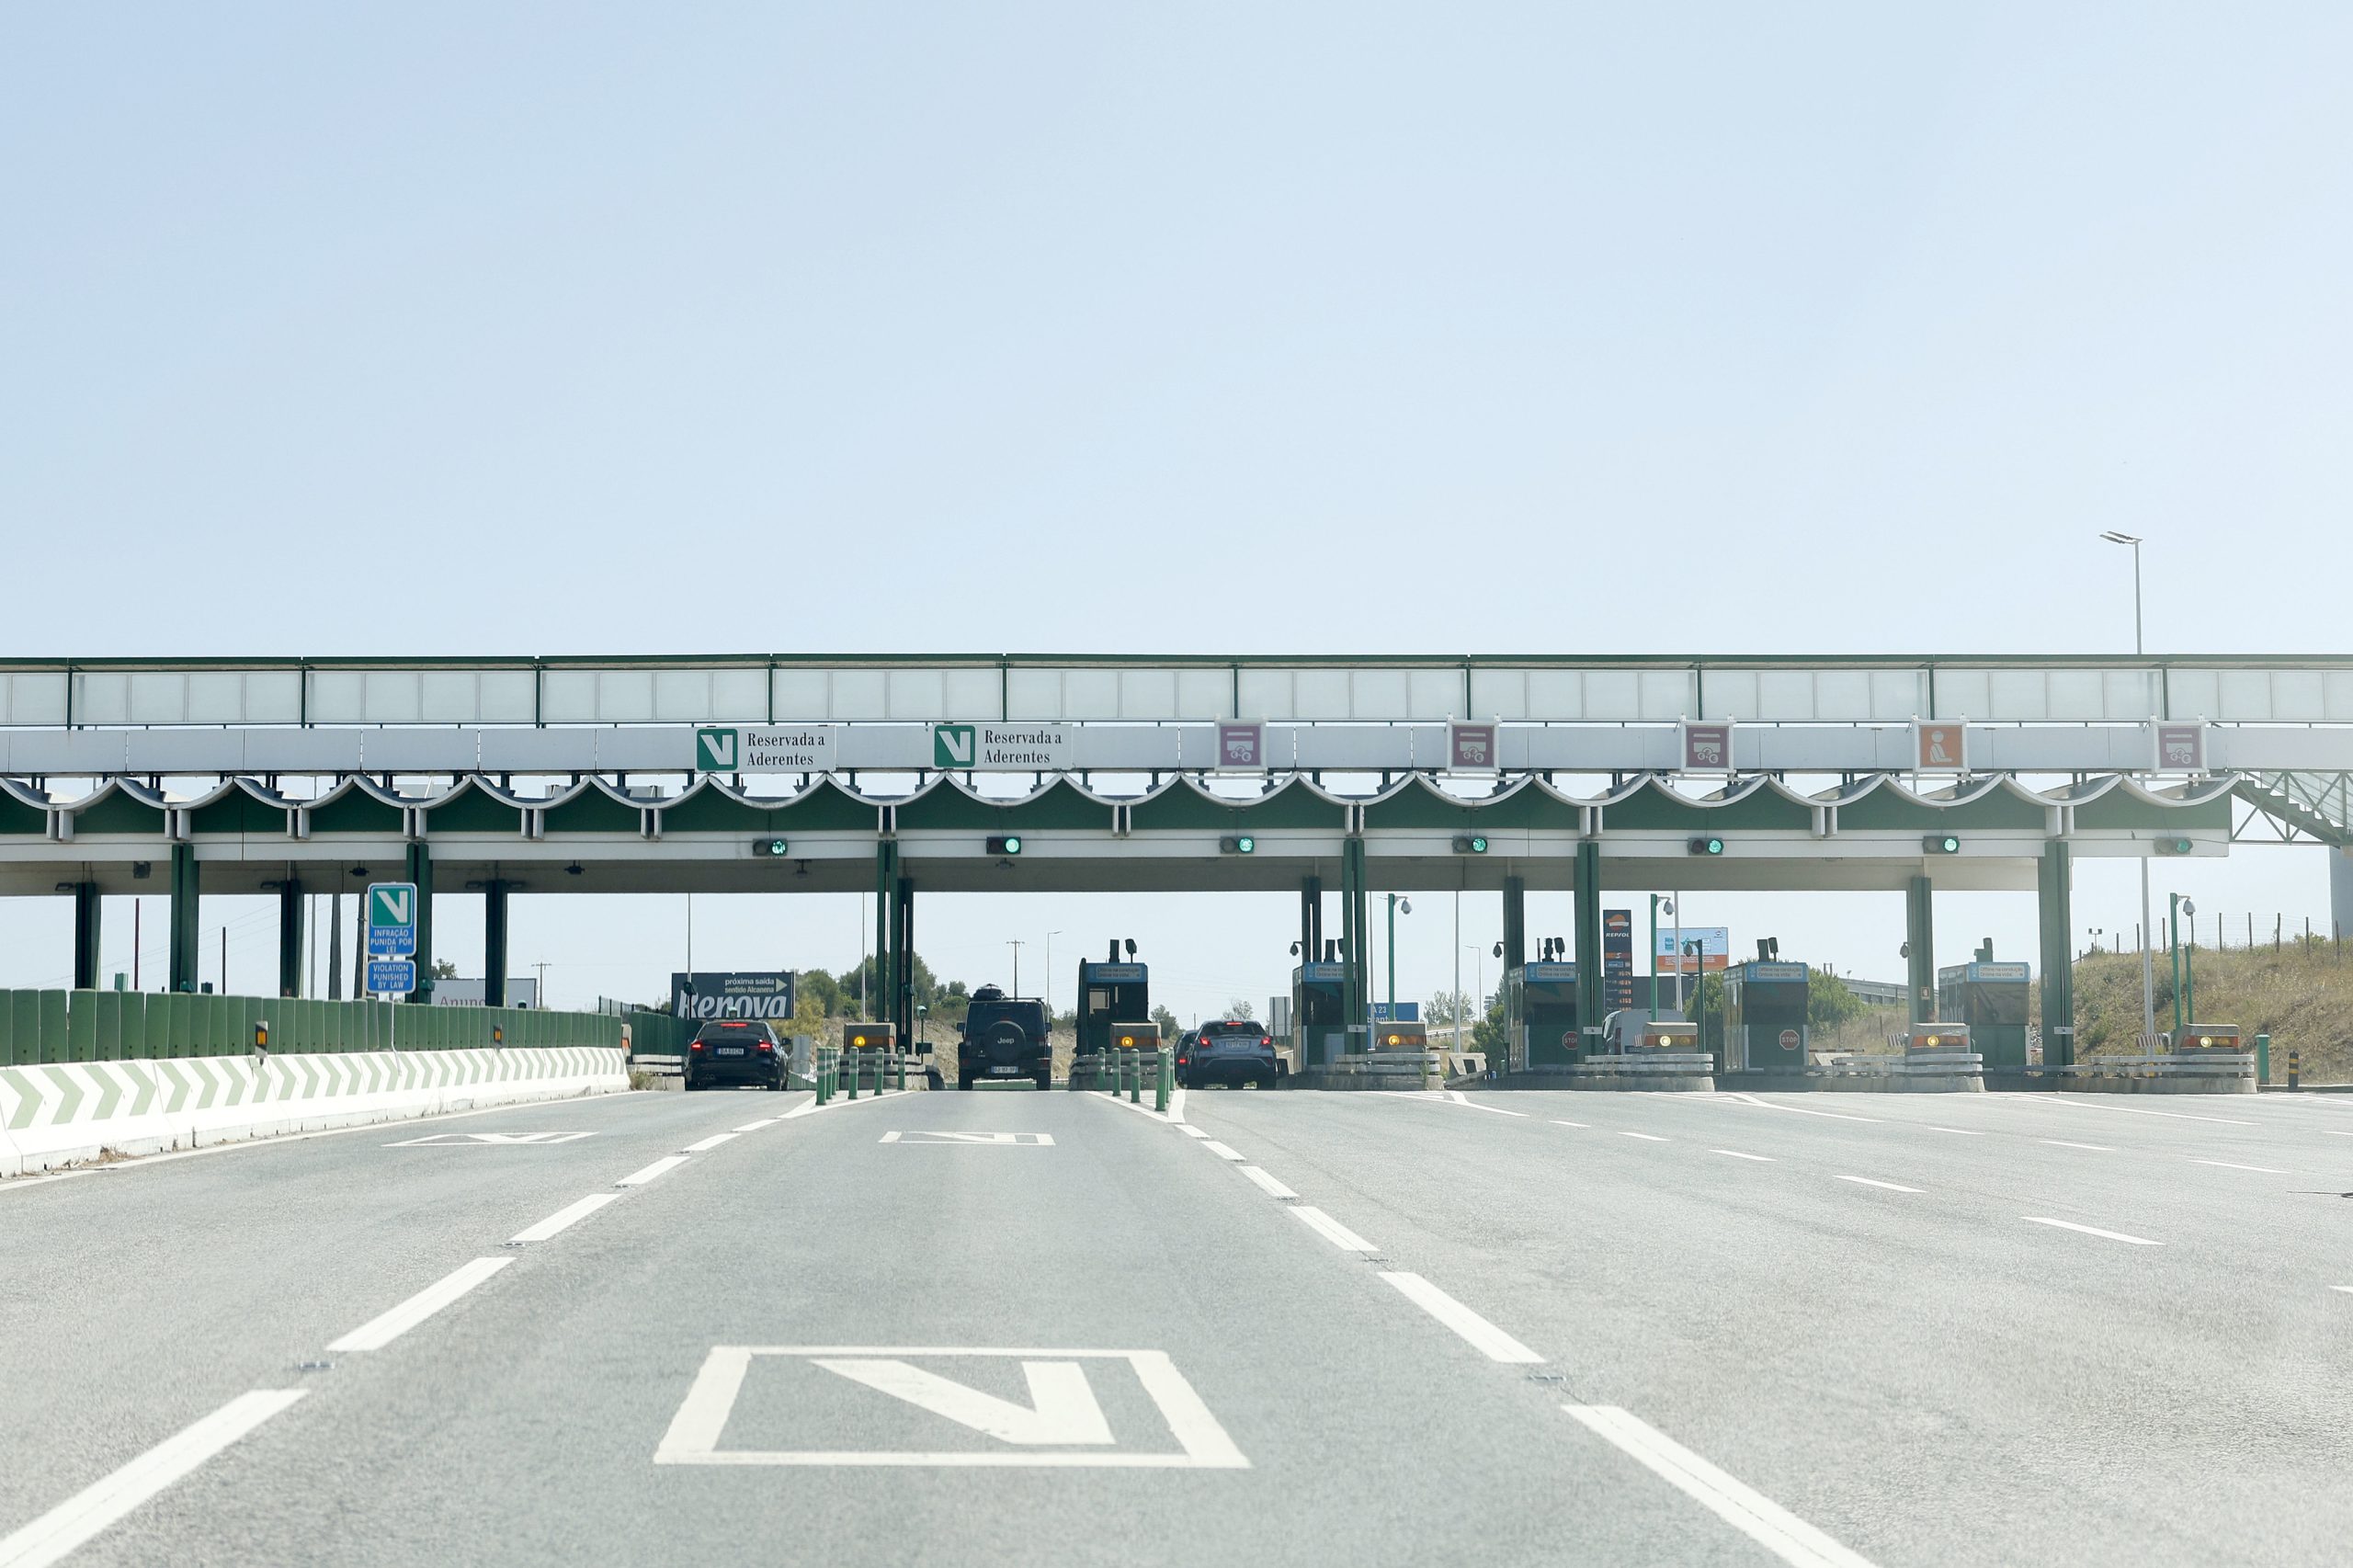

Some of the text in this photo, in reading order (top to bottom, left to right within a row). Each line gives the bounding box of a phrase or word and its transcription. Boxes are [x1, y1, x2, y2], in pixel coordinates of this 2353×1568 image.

[747, 733, 825, 746] Reservada a
[984, 730, 1063, 744] Reservada a
[747, 752, 814, 766] Aderentes
[984, 749, 1051, 763] Aderentes
[374, 928, 409, 938] INFRAÇÃO
[390, 981, 404, 989] LAW
[724, 978, 754, 986] próxima
[677, 990, 787, 1018] Renova
